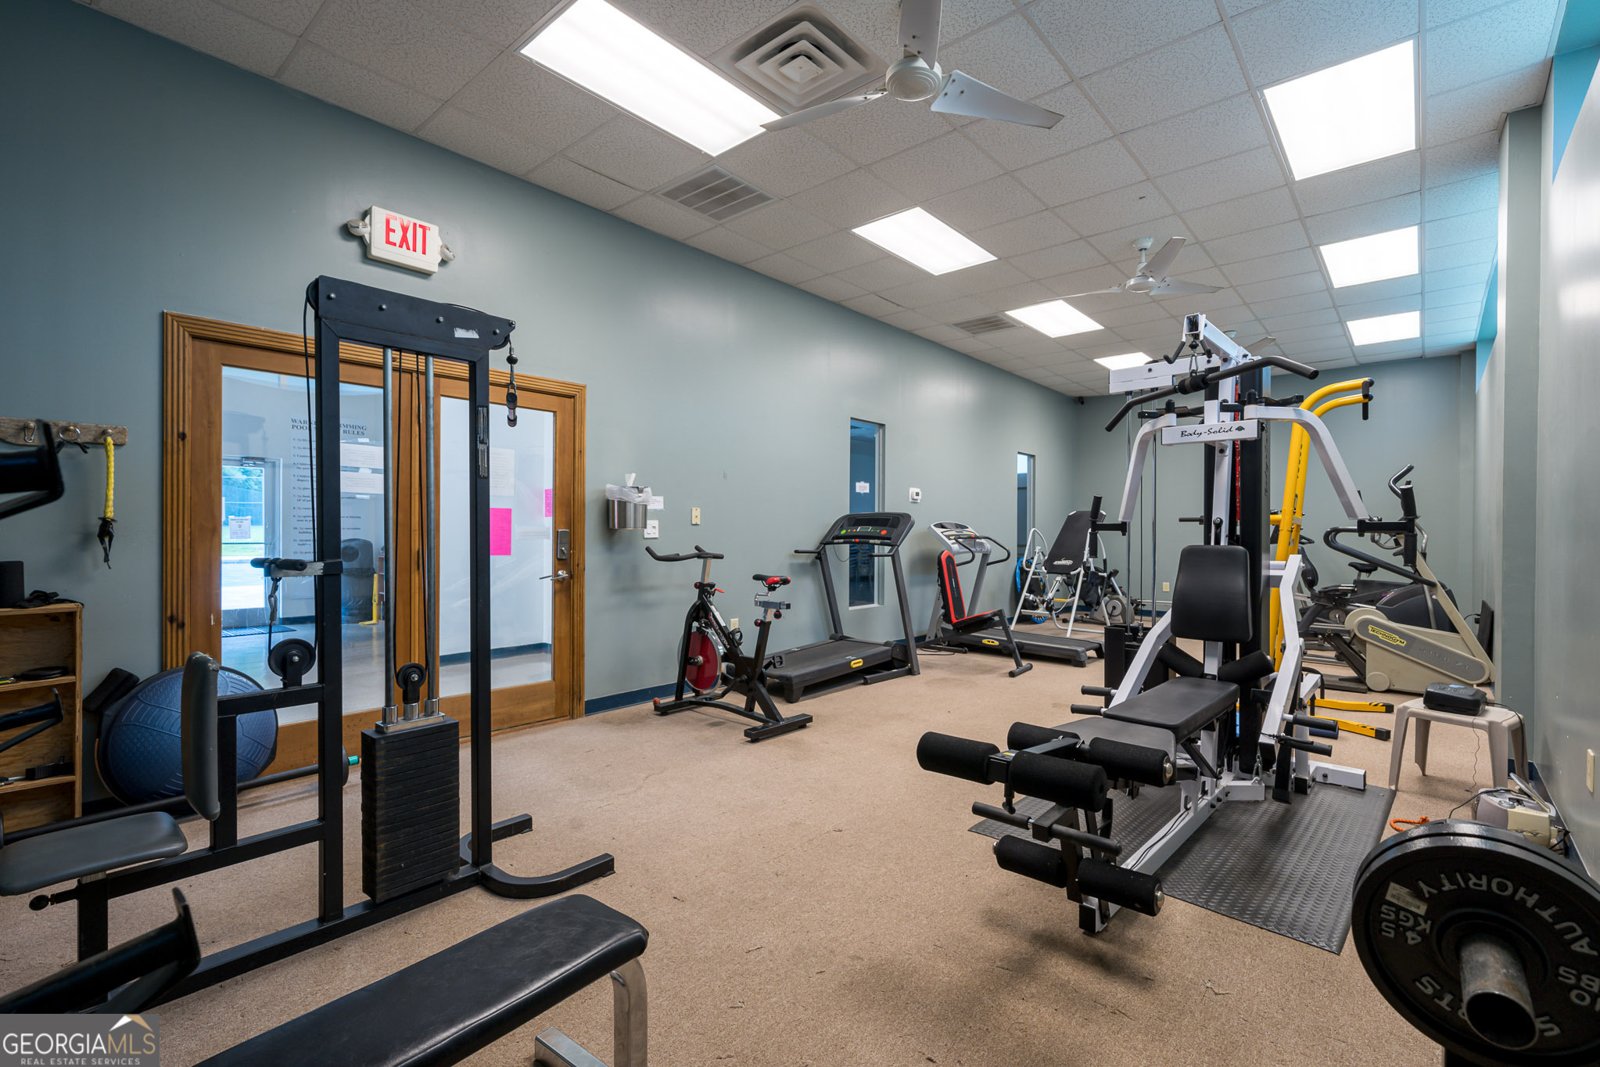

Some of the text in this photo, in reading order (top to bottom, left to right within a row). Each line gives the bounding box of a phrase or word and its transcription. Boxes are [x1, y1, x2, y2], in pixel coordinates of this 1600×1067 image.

[384, 213, 431, 256] EXIT
[290, 417, 312, 425] WAR
[1180, 425, 1234, 438] Body-Solid
[1380, 903, 1432, 933] KGS
[1417, 871, 1599, 957] AUTHORITY
[1557, 966, 1600, 993] BS
